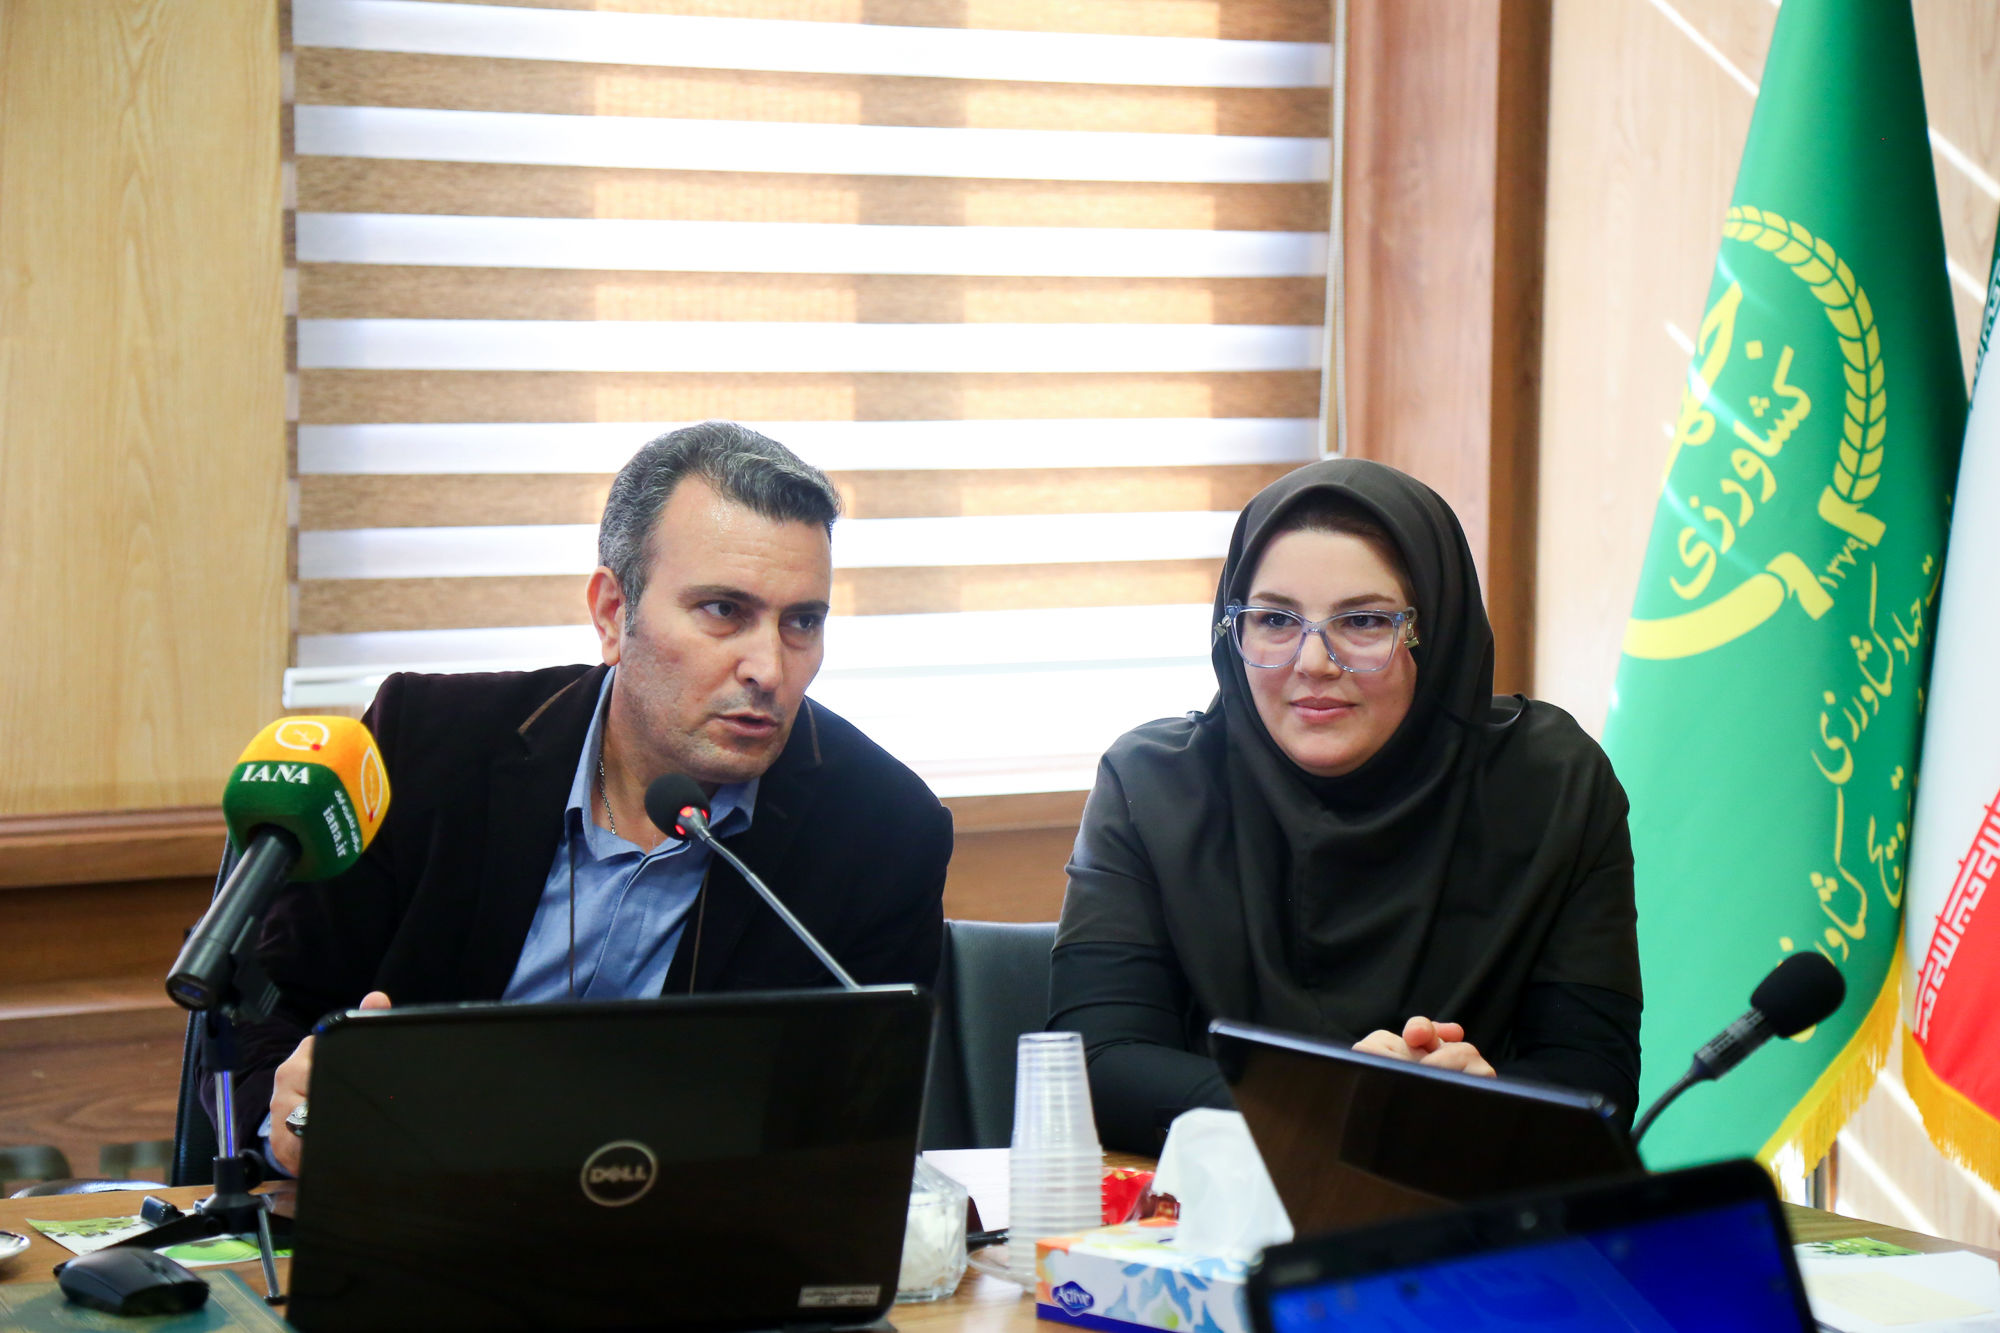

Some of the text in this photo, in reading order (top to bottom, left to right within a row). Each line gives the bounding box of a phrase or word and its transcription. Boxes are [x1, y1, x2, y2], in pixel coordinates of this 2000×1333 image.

[240, 764, 309, 784] IANA
[322, 804, 347, 857] iana.ir
[589, 1165, 647, 1184] DELL
